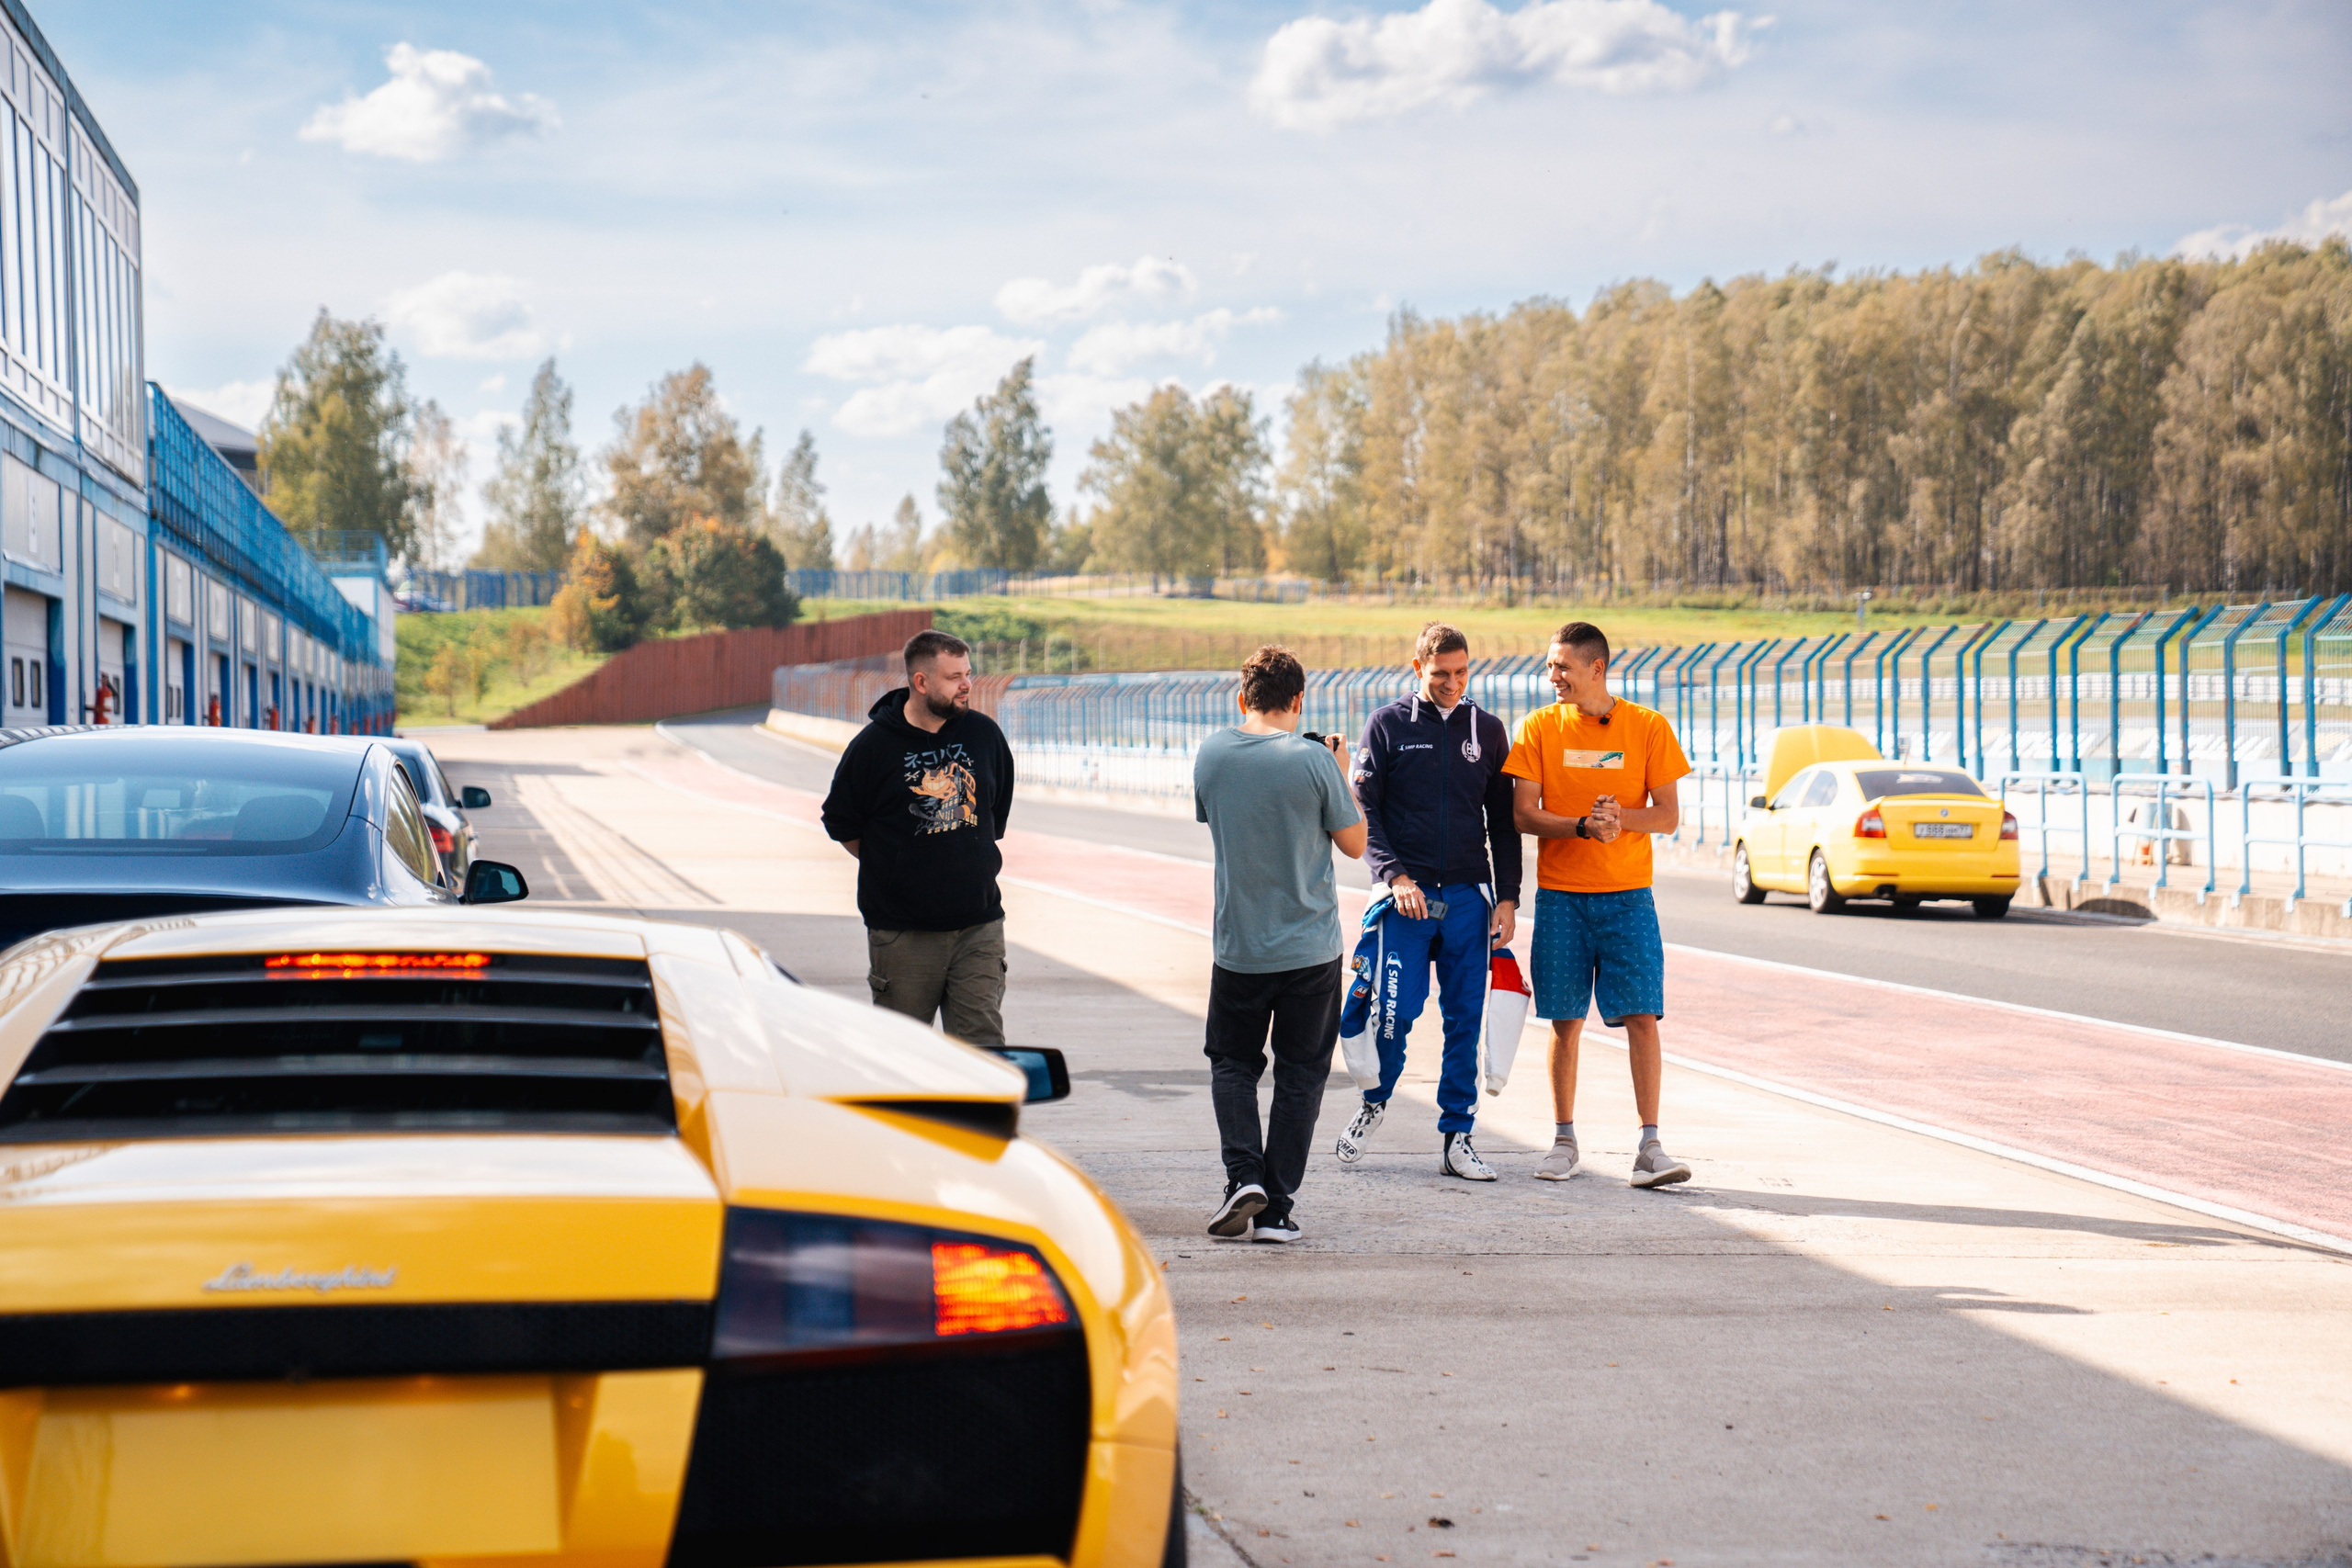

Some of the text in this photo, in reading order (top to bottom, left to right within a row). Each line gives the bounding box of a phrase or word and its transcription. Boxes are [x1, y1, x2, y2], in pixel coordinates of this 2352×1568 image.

[904, 743, 967, 768] ネコバス
[1384, 969, 1397, 1040] SMP RACING
[201, 1262, 397, 1292] Lamborghini
